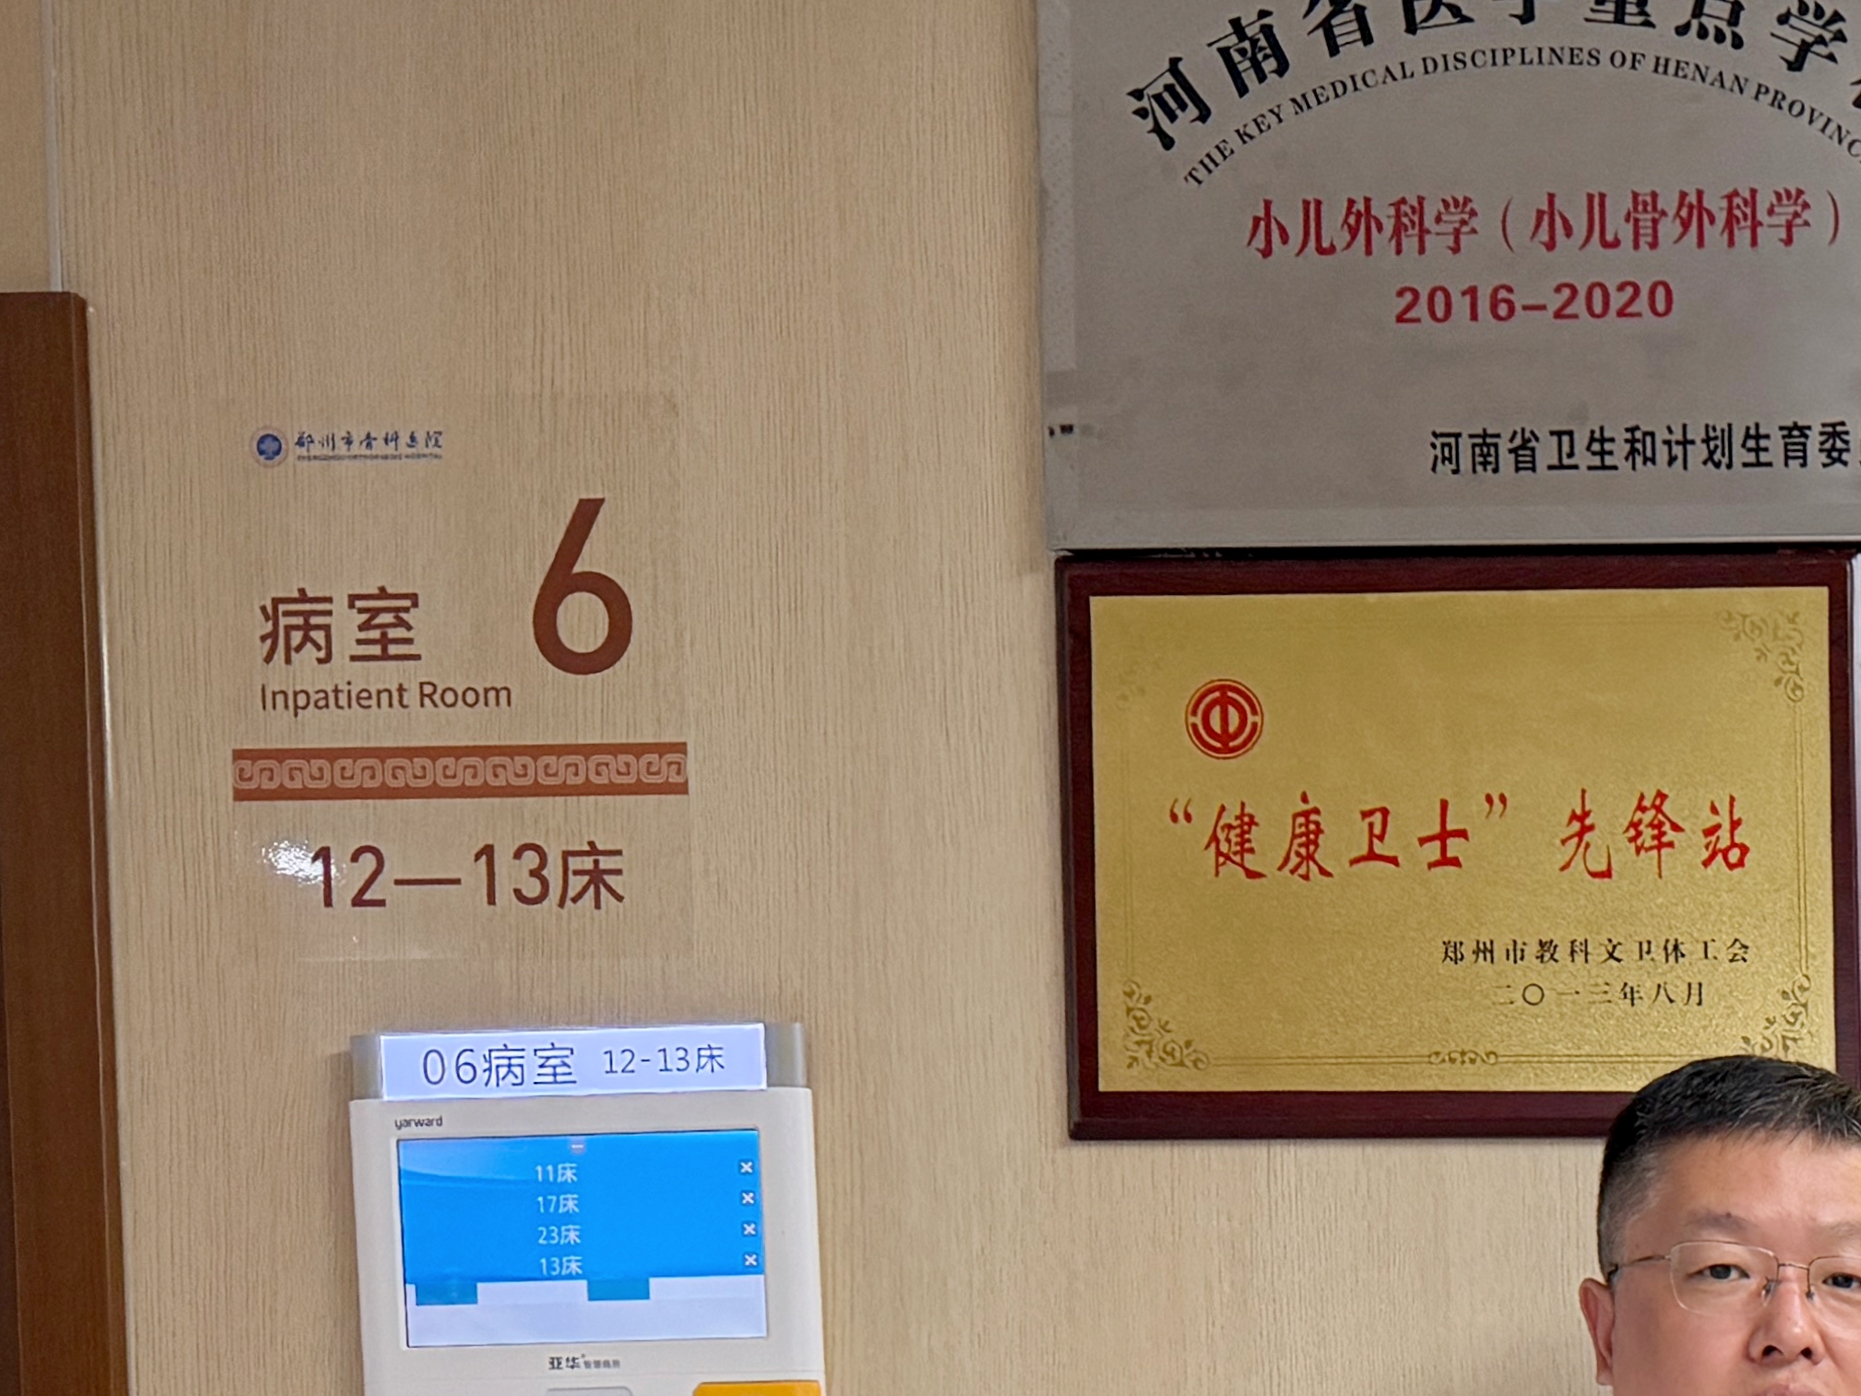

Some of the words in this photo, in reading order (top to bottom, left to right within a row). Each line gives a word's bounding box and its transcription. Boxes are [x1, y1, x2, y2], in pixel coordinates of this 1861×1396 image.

[1183, 139, 1235, 188] THE
[1240, 103, 1284, 146] KEY
[1289, 61, 1415, 116] MEDICAL
[1420, 46, 1601, 77] DISCIPLINES
[1609, 49, 1647, 72] OF
[1651, 56, 1749, 96] HENAN
[533, 497, 633, 676] 6
[259, 586, 422, 666] 病室
[260, 681, 409, 718] Inpatient
[418, 681, 512, 709] Room
[1441, 937, 1752, 967] 郑州市教科文卫体工会
[423, 1042, 578, 1089] 06病室
[603, 1044, 727, 1076] 12-13床
[394, 1114, 443, 1131] yarward
[535, 1163, 578, 1184] 11床
[536, 1194, 580, 1216] 17床
[537, 1225, 582, 1247] 23床
[539, 1256, 584, 1278] 13床
